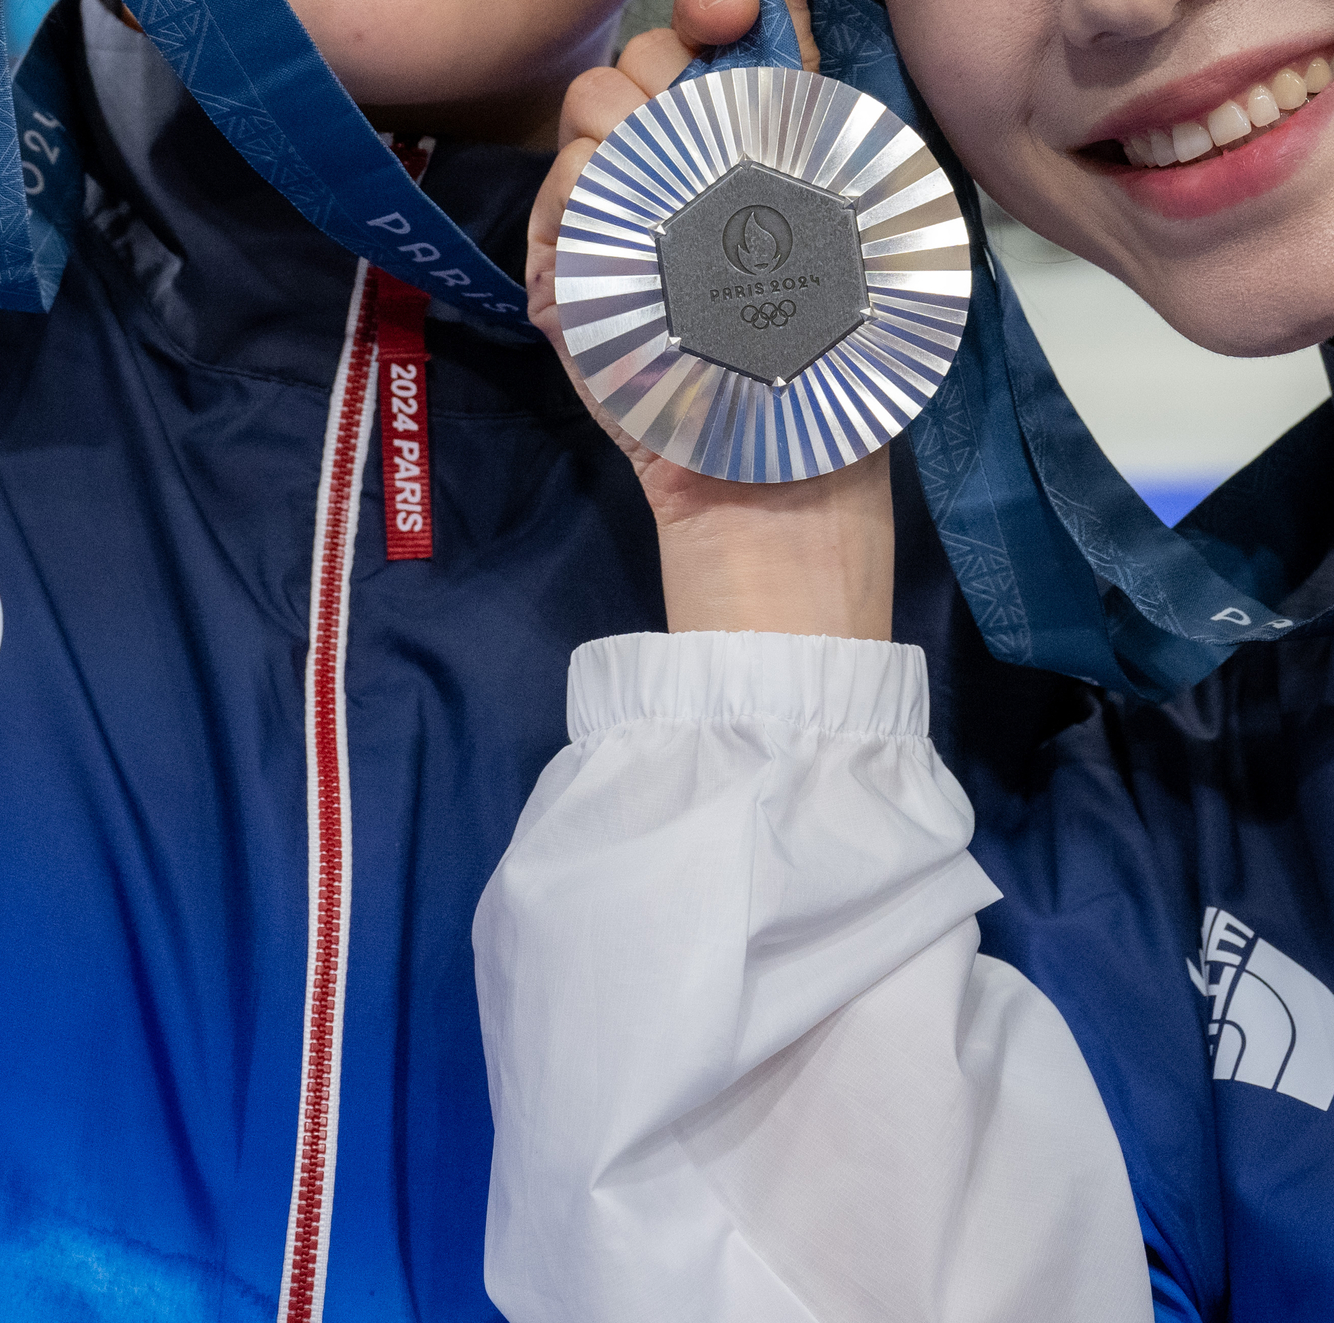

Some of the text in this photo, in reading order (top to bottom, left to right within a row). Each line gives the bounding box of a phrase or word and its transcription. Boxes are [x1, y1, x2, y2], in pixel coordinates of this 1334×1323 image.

[366, 211, 520, 314] PARIS
[709, 274, 821, 303] PARIS 2024
[390, 362, 424, 533] 2024 PARIS
